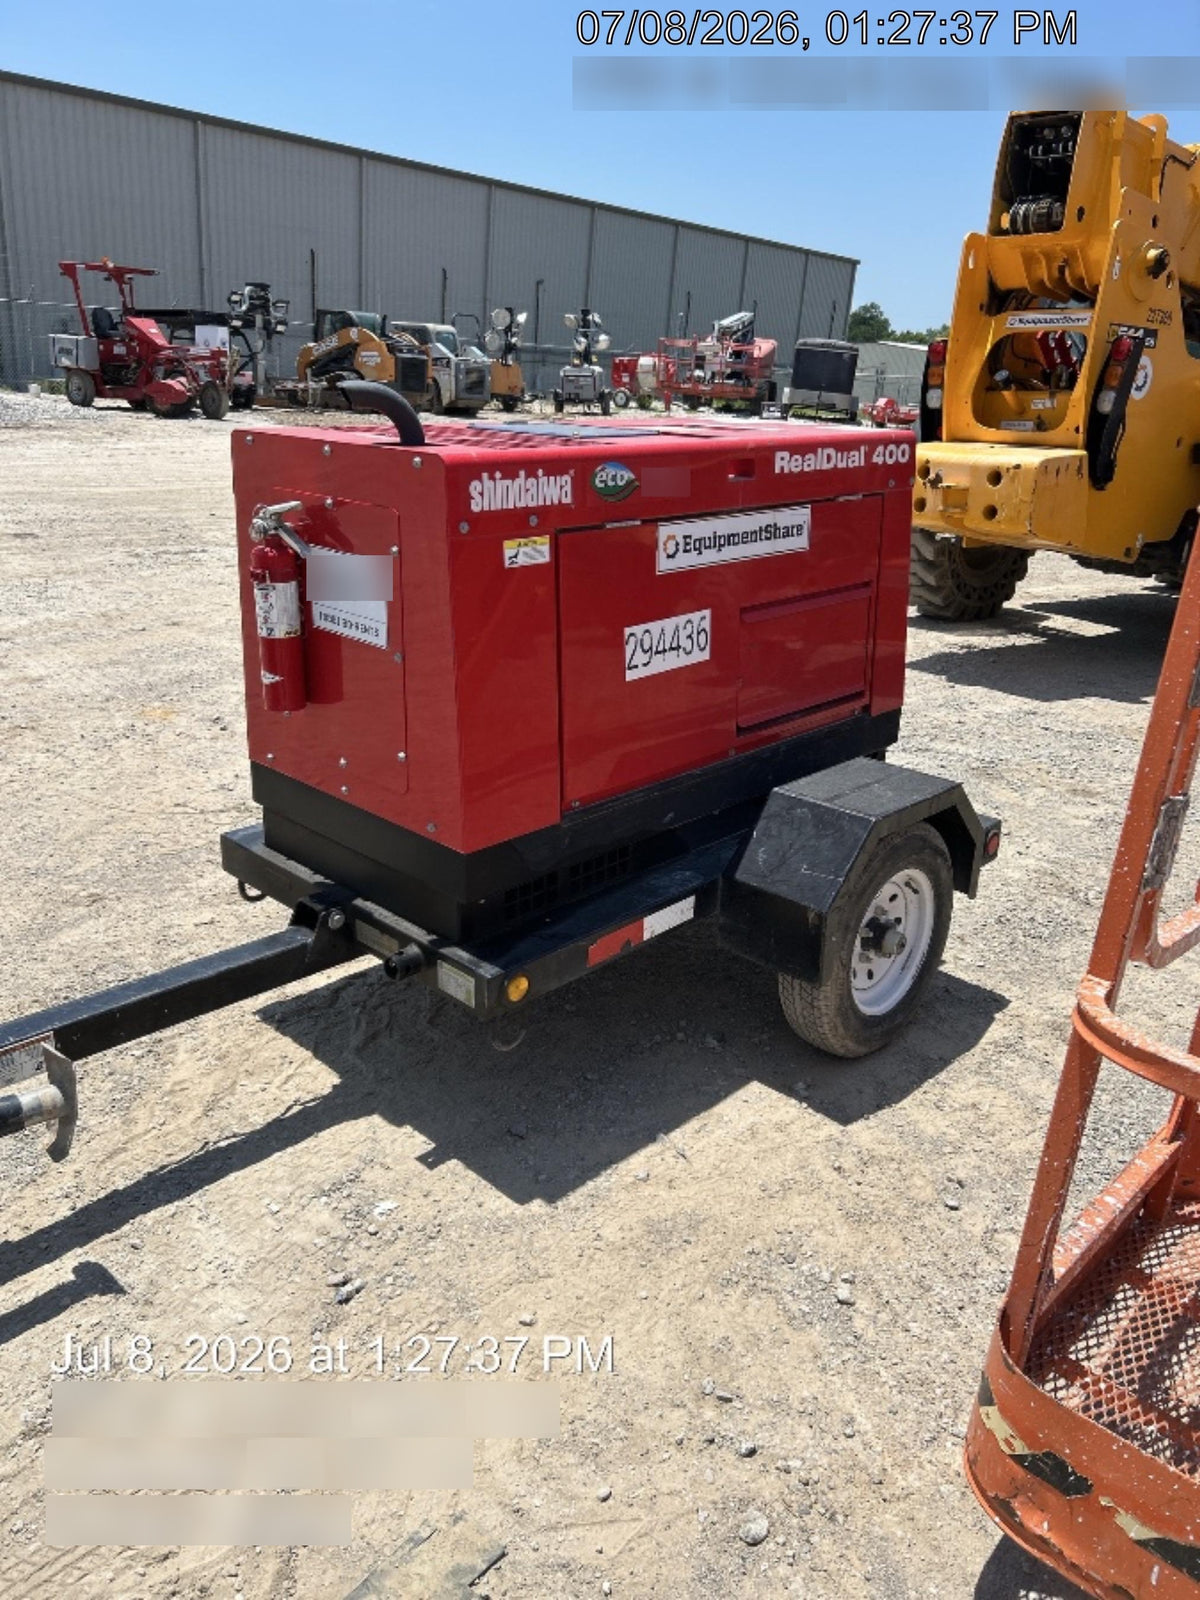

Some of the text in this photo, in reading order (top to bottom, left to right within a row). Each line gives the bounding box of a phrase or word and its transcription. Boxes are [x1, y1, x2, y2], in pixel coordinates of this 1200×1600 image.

[774, 443, 911, 474] RealDual 400
[469, 468, 573, 512] shindaiwa
[595, 470, 628, 488] eco
[682, 522, 804, 556] EquipmentShare
[625, 615, 708, 671] 294436
